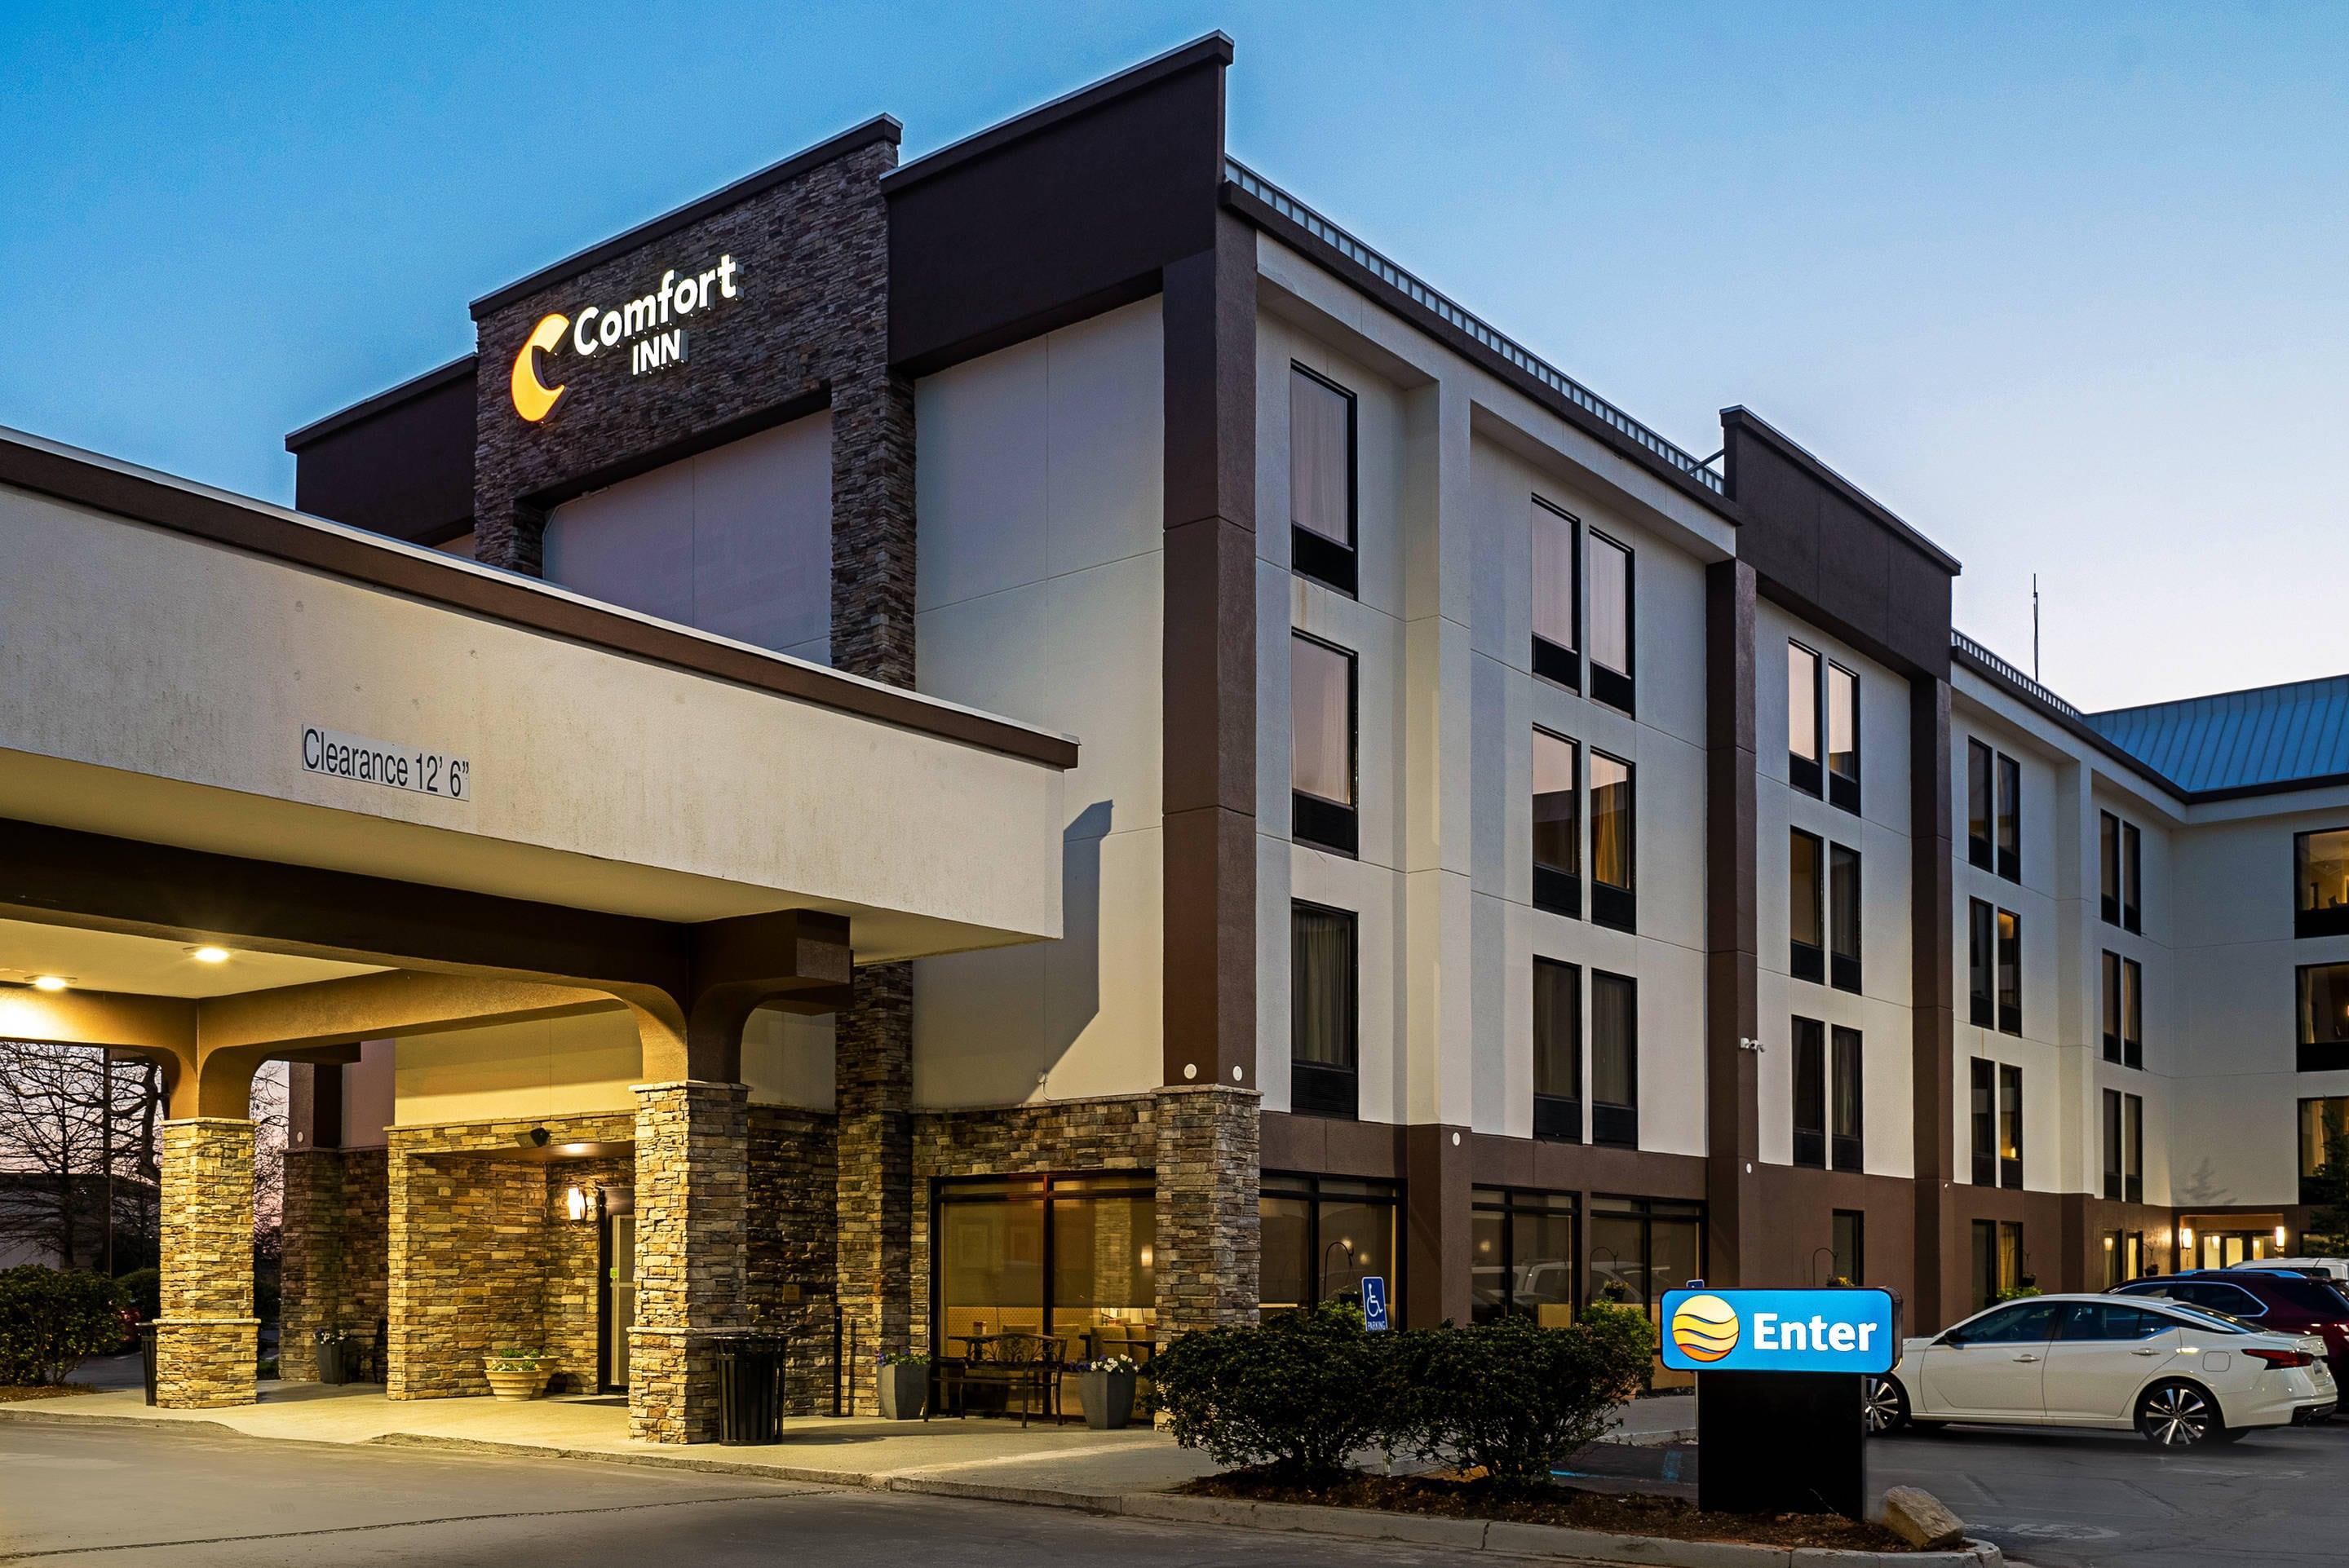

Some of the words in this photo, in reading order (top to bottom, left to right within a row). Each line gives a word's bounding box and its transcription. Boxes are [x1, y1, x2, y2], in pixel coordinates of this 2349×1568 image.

[573, 254, 737, 356] Comfort
[632, 328, 682, 376] INN
[303, 727, 409, 787] Clearance
[1367, 1321, 1386, 1331] PARKING
[1753, 1312, 1878, 1352] Enter
